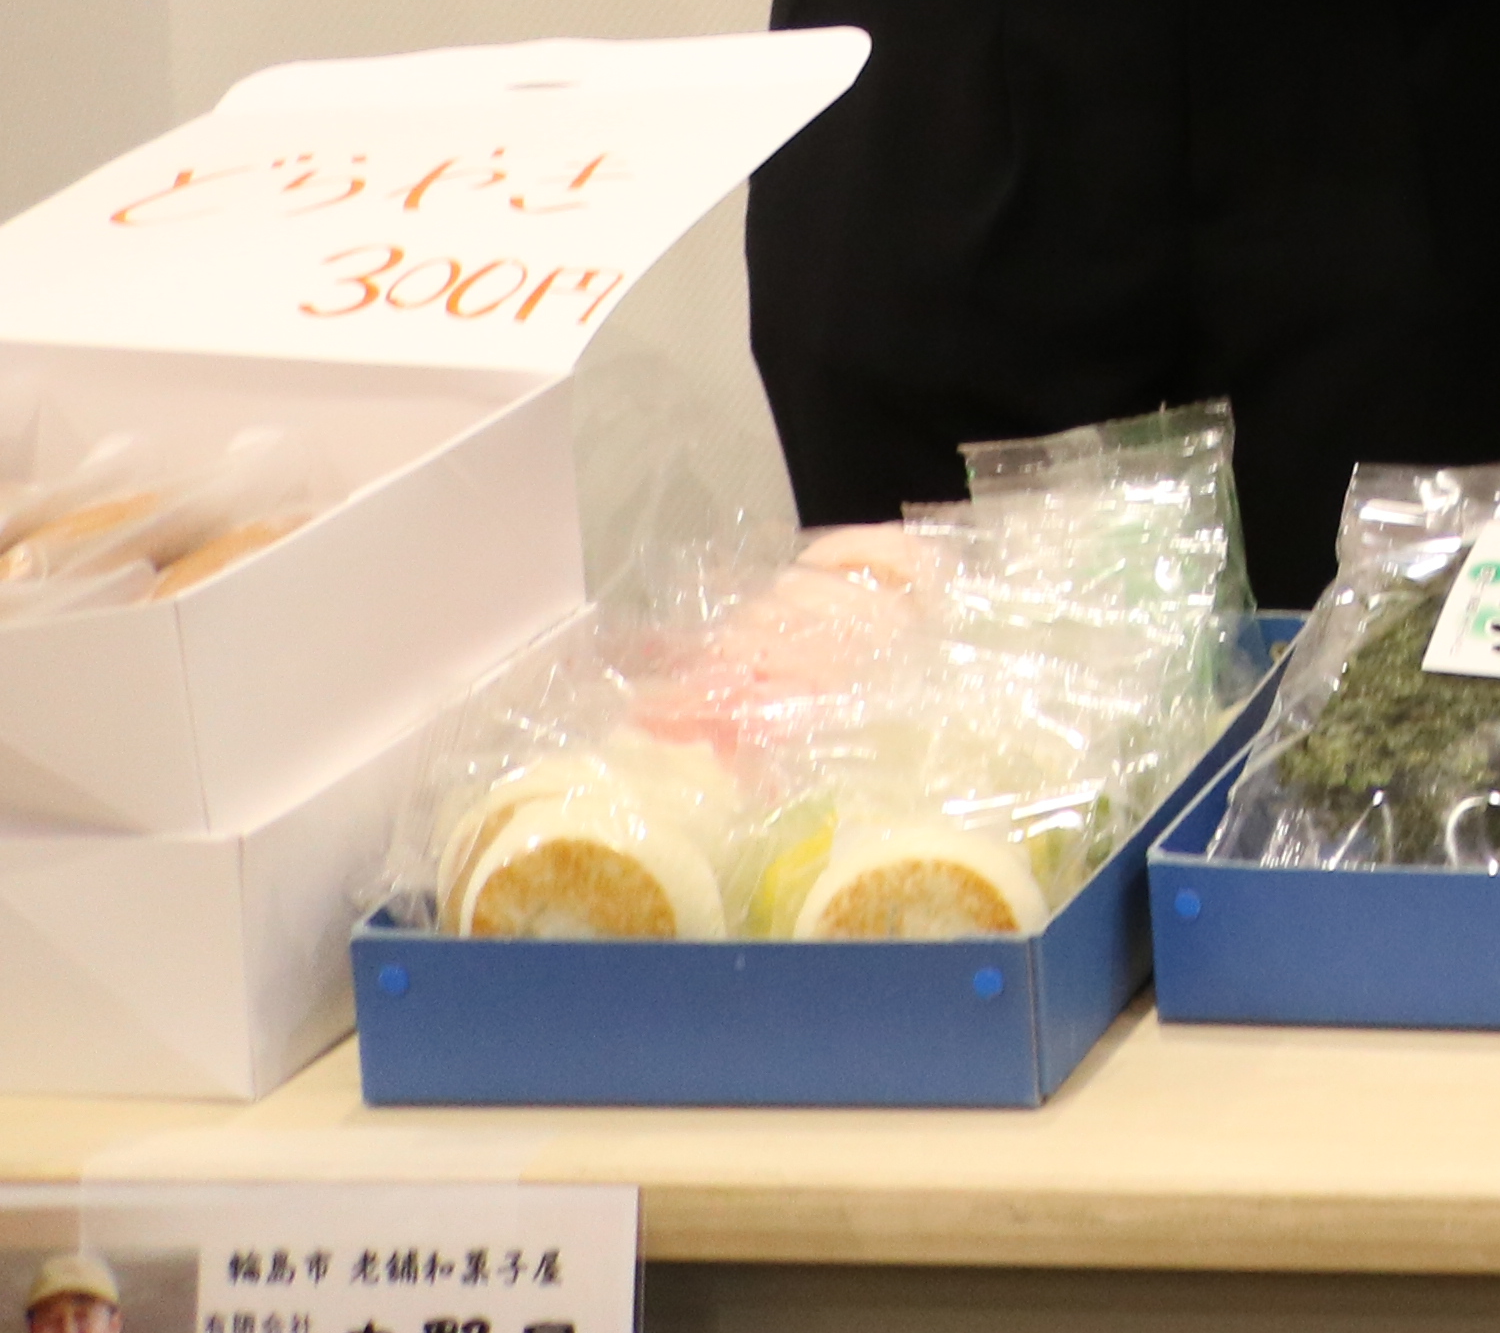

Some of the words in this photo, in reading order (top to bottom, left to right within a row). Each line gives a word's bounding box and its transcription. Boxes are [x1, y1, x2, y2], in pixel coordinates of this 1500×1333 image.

[109, 145, 633, 229] どらやき
[297, 243, 625, 326] 300円
[228, 1247, 332, 1287] 輪島市
[352, 1246, 563, 1287] 老舗和菓子屋
